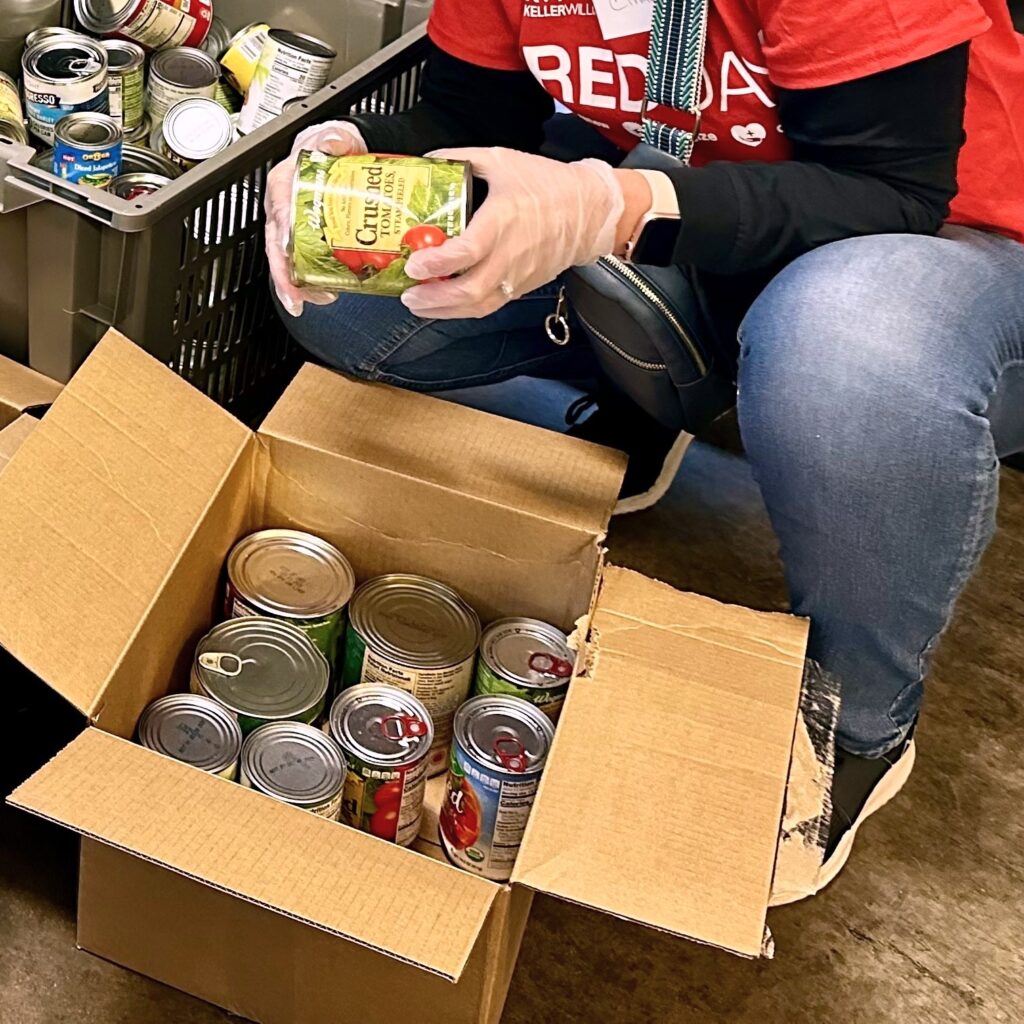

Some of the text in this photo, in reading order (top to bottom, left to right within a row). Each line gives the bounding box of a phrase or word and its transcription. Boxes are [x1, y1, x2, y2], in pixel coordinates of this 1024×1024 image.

[277, 48, 312, 64] Nutrition Facts
[522, 44, 657, 113] RED
